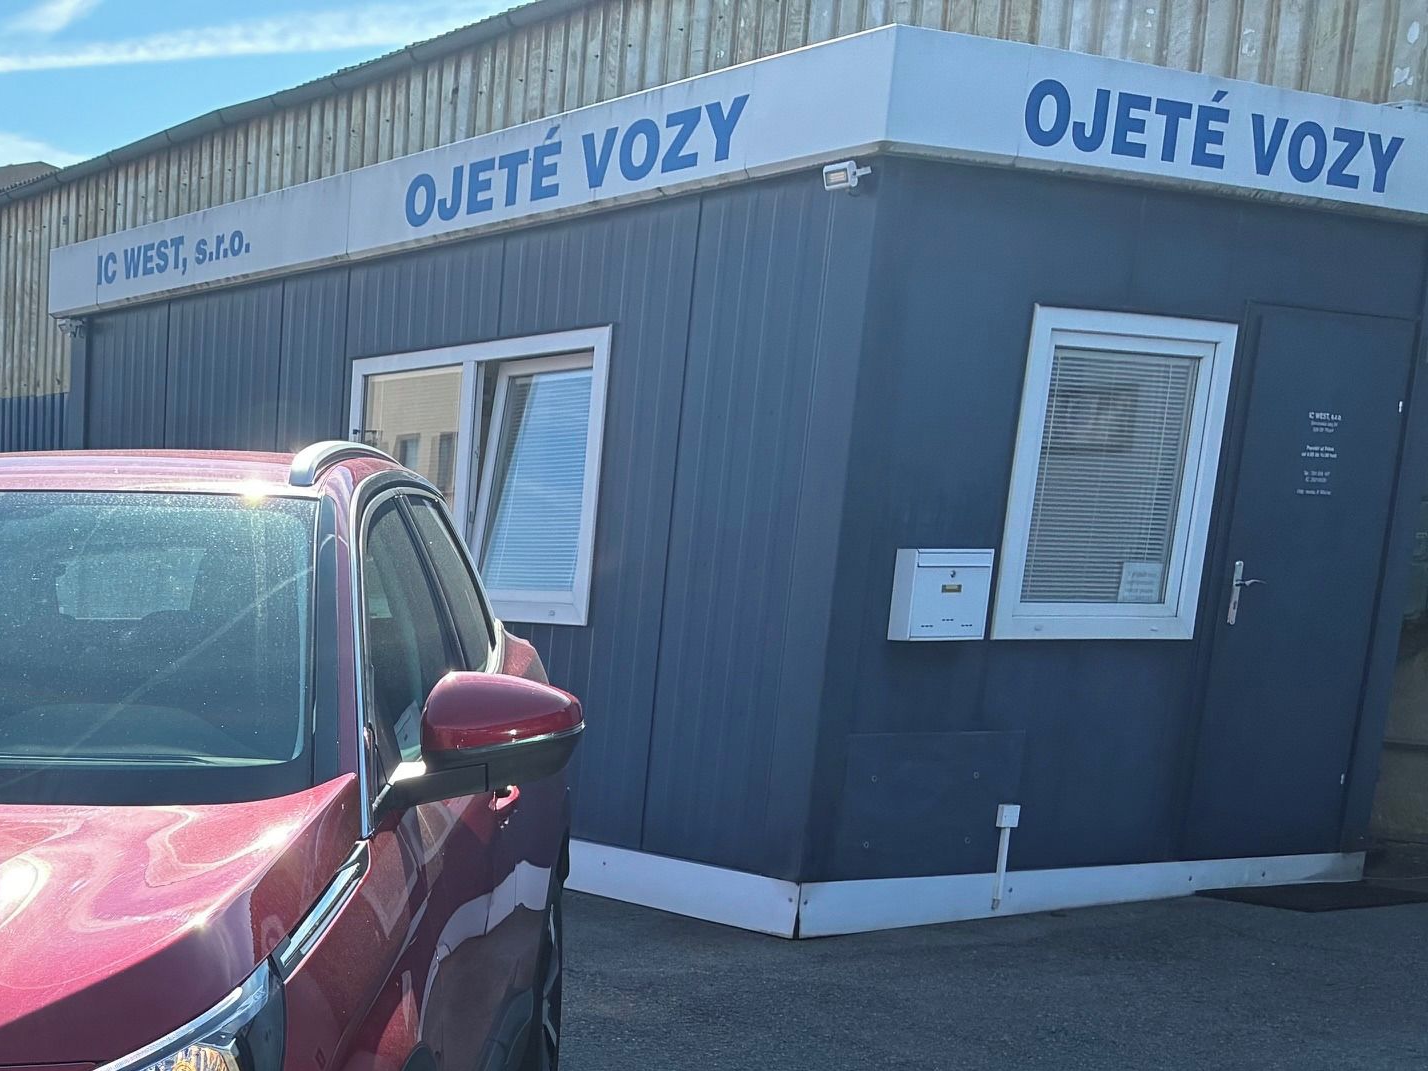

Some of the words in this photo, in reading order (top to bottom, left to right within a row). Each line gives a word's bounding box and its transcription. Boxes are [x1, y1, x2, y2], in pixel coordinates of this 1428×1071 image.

[405, 125, 563, 228] OJETÉ
[582, 94, 750, 189] VOZY
[1024, 79, 1230, 170] OJETÉ
[1251, 113, 1405, 194] VOZY
[97, 252, 118, 286] IC
[124, 235, 188, 280] WEST,
[195, 230, 251, 265] s.r.o.
